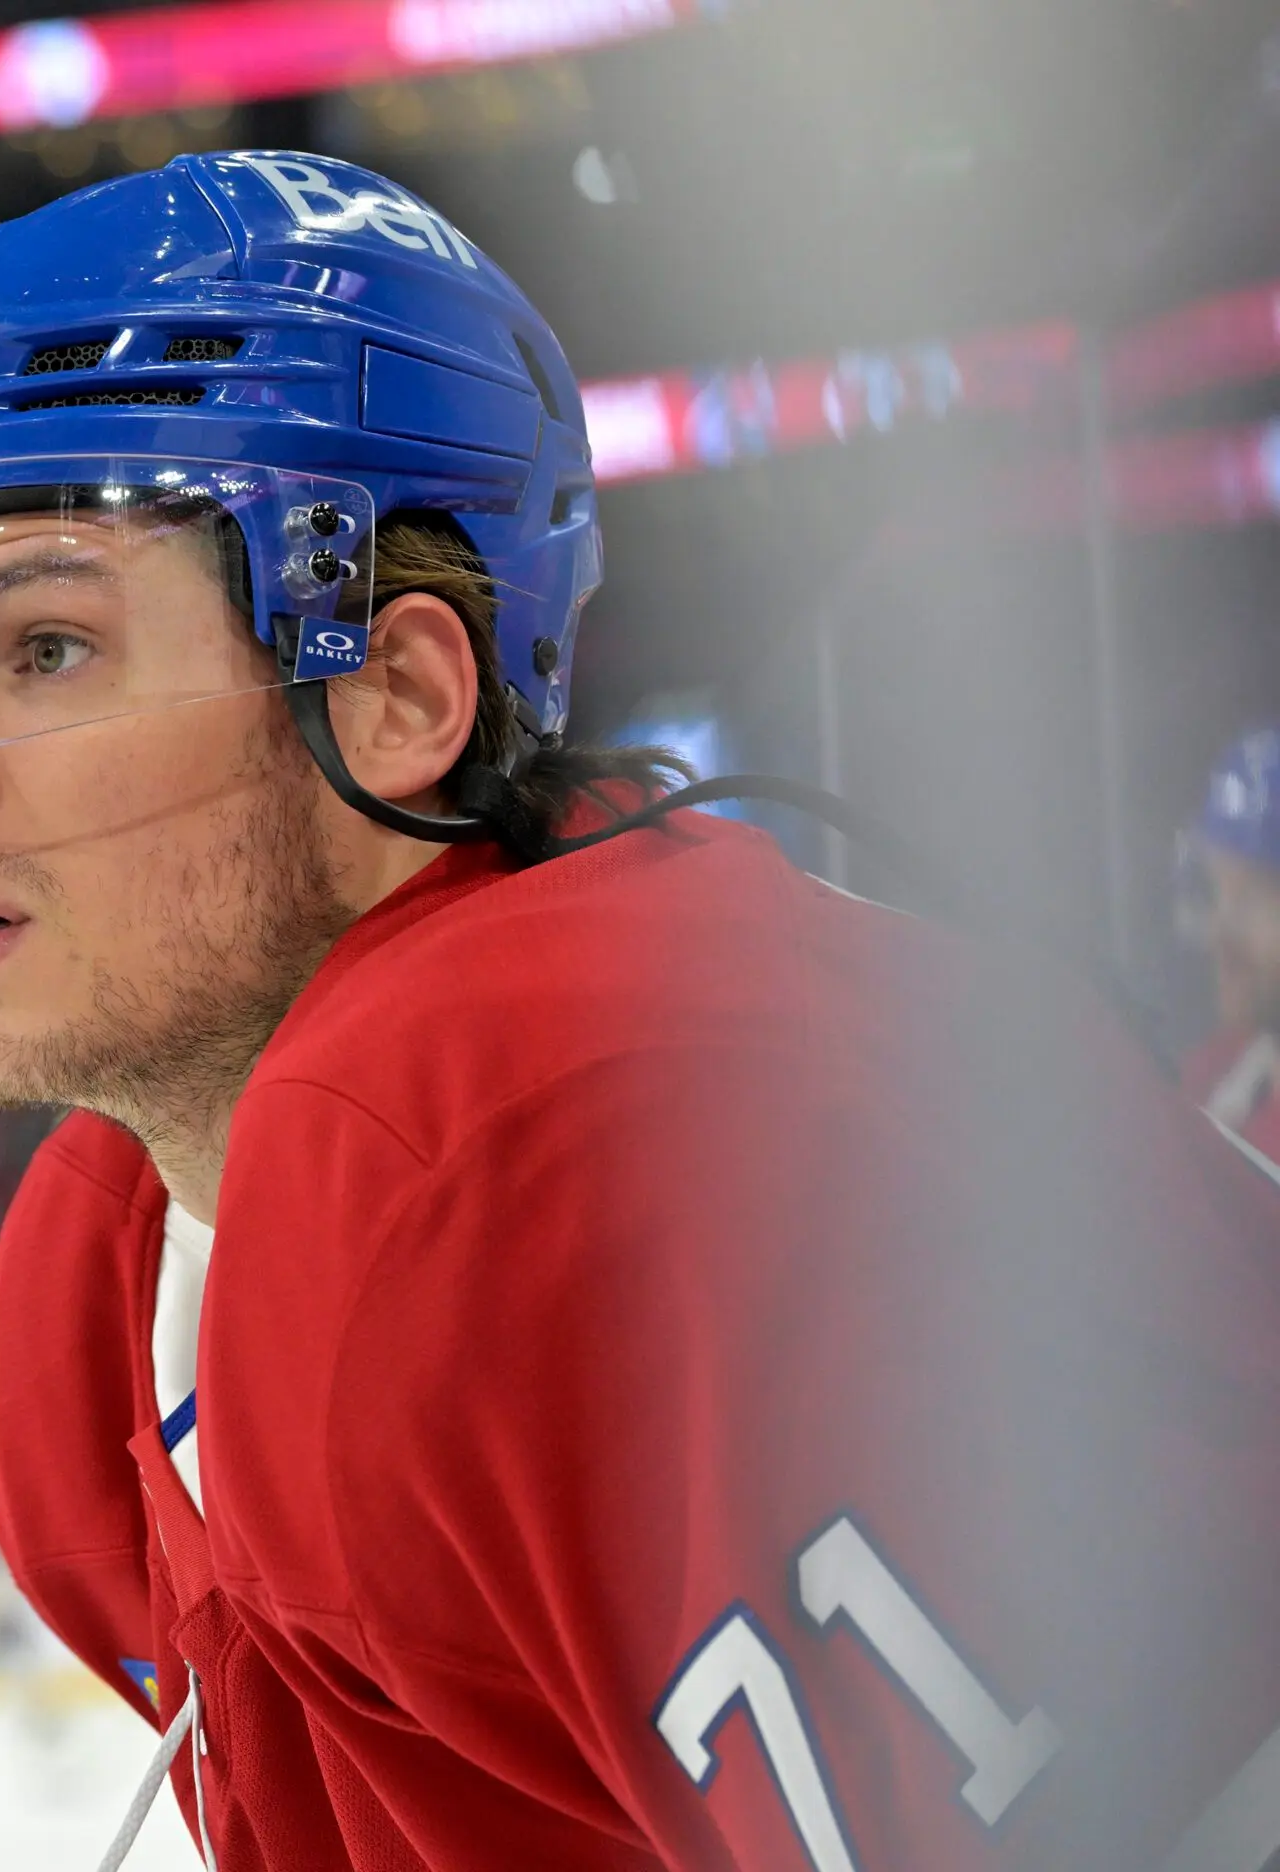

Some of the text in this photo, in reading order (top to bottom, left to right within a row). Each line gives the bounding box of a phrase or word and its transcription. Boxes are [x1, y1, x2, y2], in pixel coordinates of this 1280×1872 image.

[246, 157, 478, 270] Bell
[305, 645, 362, 664] OAKLEY
[652, 1512, 1064, 1872] 71
